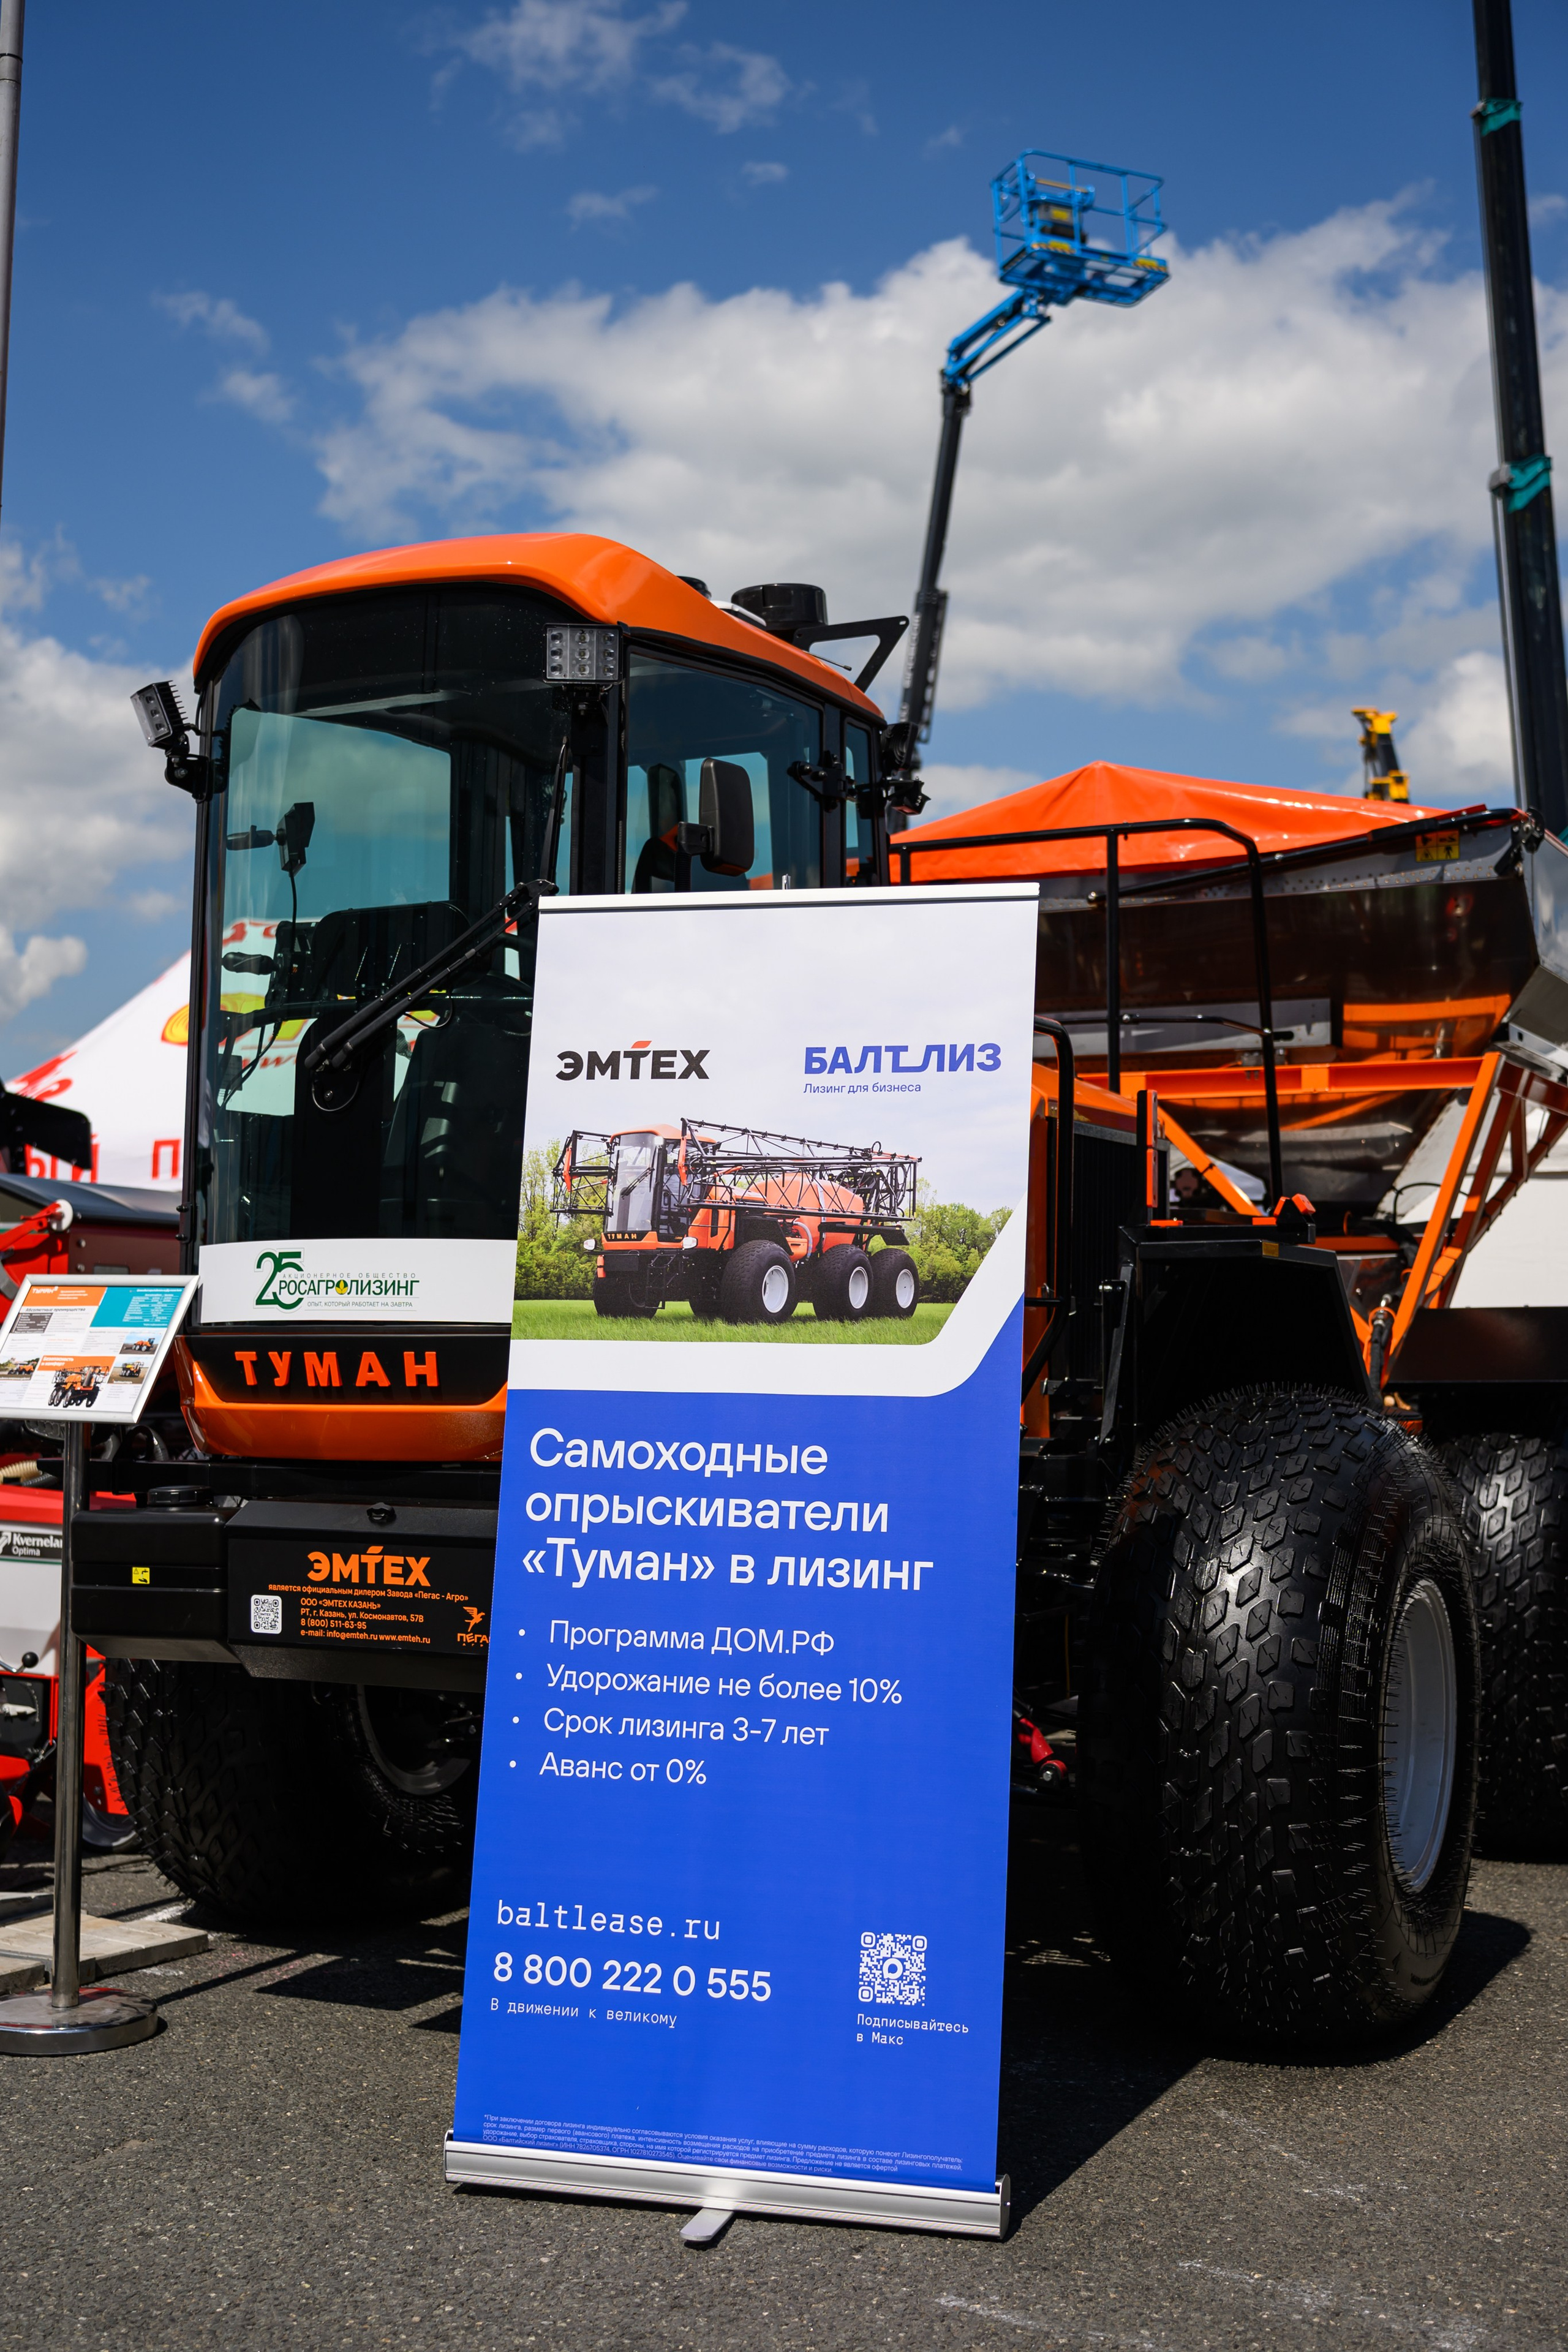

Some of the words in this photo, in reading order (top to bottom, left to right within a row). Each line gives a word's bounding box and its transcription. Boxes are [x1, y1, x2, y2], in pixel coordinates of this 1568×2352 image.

[556, 1041, 710, 1081] ЭМТЕХ
[804, 1082, 846, 1096] Лизинг
[848, 1084, 869, 1095] для
[872, 1082, 921, 1094] бизнеса
[255, 1251, 304, 1310] 25
[279, 1280, 420, 1295] РОСАГРОЛИЗИНГ
[235, 1351, 438, 1387] ТУМАН
[530, 1428, 828, 1478] Самоходные
[526, 1492, 889, 1533] опрыскиватели
[12, 1545, 40, 1556] Optima
[307, 1546, 431, 1586] ЭМТЕХ
[522, 1537, 715, 1588] «Туман»
[730, 1555, 755, 1583] в
[767, 1556, 933, 1591] лизинг
[268, 1583, 301, 1593] является
[303, 1585, 353, 1596] официальным
[354, 1588, 385, 1597] дилером
[386, 1589, 413, 1599] Завода
[414, 1591, 440, 1600] «Пегас
[446, 1593, 469, 1602] Агро»
[318, 1599, 347, 1608] «ЭМТЕХ
[348, 1600, 380, 1610] КАЗАНЬ»
[301, 1608, 311, 1617] РТ,
[319, 1609, 347, 1619] Казань,
[360, 1611, 409, 1623] Космонавтов,
[410, 1614, 424, 1623] 57В
[307, 1618, 328, 1628] (800)
[330, 1620, 367, 1629] 511-63-95
[301, 1628, 325, 1637] e-mail:
[326, 1629, 378, 1641] info@emteh.ru
[379, 1634, 431, 1644] www.emteh.ru
[457, 1633, 491, 1643] ПЕГА
[549, 1620, 704, 1652] Программа
[712, 1627, 834, 1655] ДОМ.РФ
[546, 1664, 710, 1695] Удорожание
[718, 1676, 750, 1696] не
[759, 1673, 842, 1700] более
[848, 1678, 902, 1704] 10%
[543, 1707, 612, 1738] Срок
[619, 1717, 725, 1740] лизинга
[782, 1725, 830, 1746] лет
[539, 1752, 623, 1780] Аванс
[630, 1760, 660, 1781] от
[666, 1759, 706, 1784] 0%
[497, 1899, 721, 1940] baltlease.ru
[494, 1952, 513, 1982] 8
[524, 1954, 592, 1988] 800
[603, 1960, 662, 1994] 222
[673, 1965, 695, 1996] 0
[707, 1968, 772, 2002] 555
[491, 1999, 499, 2011] В
[507, 2002, 579, 2018] движении
[589, 2008, 597, 2019] к
[606, 2009, 677, 2029] великому
[858, 2013, 969, 2034] Подписывайтесь
[856, 2033, 864, 2042] в
[871, 2032, 904, 2046] Макс
[500, 2116, 533, 2124] заключении
[587, 2124, 630, 2133] индивидуально
[632, 2128, 683, 2138] согласовываются
[483, 2128, 518, 2137] удорожание,
[538, 2135, 578, 2143] страхователя,
[579, 2138, 618, 2147] страховщика,
[692, 2148, 739, 2157] регистрируется
[793, 2156, 834, 2166] Предложение
[499, 2136, 535, 2145] «Балтийский
[677, 2153, 713, 2162] Оценивайте
[729, 2158, 766, 2167] финансовые
[767, 2162, 807, 2171] возможности
[573, 2129, 609, 2139] (авансового)
[638, 2136, 682, 2145] интенсивность
[684, 2140, 720, 2149] возмещения
[761, 2147, 804, 2156] приобретение
[895, 2159, 930, 2168] лизинговых
